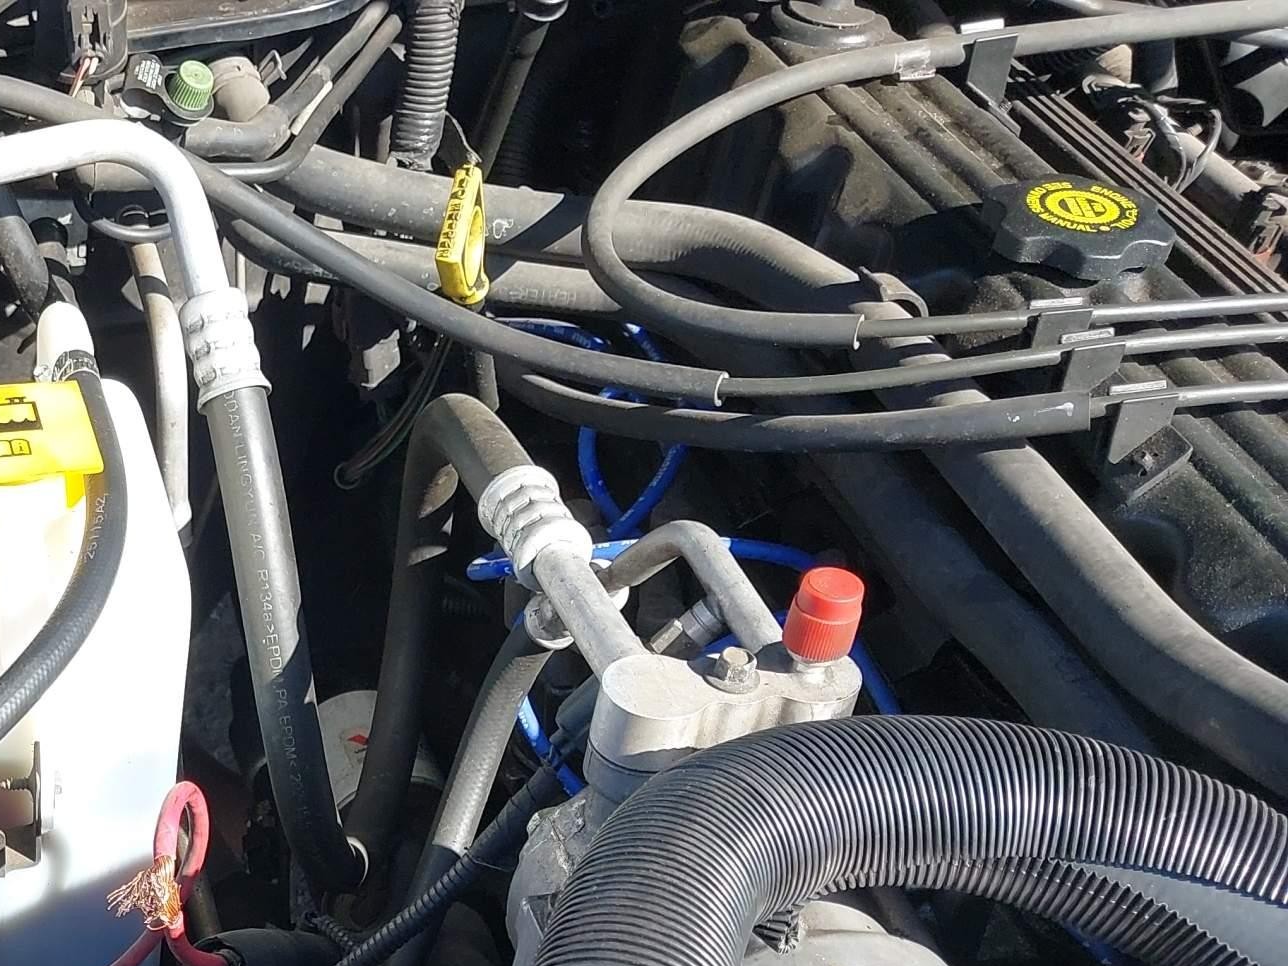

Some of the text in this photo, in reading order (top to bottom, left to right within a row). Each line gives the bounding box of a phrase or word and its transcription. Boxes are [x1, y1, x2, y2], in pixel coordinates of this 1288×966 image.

[1041, 181, 1073, 191] SEE
[1090, 185, 1137, 209] ENGINE
[1038, 213, 1098, 233] MANUAL
